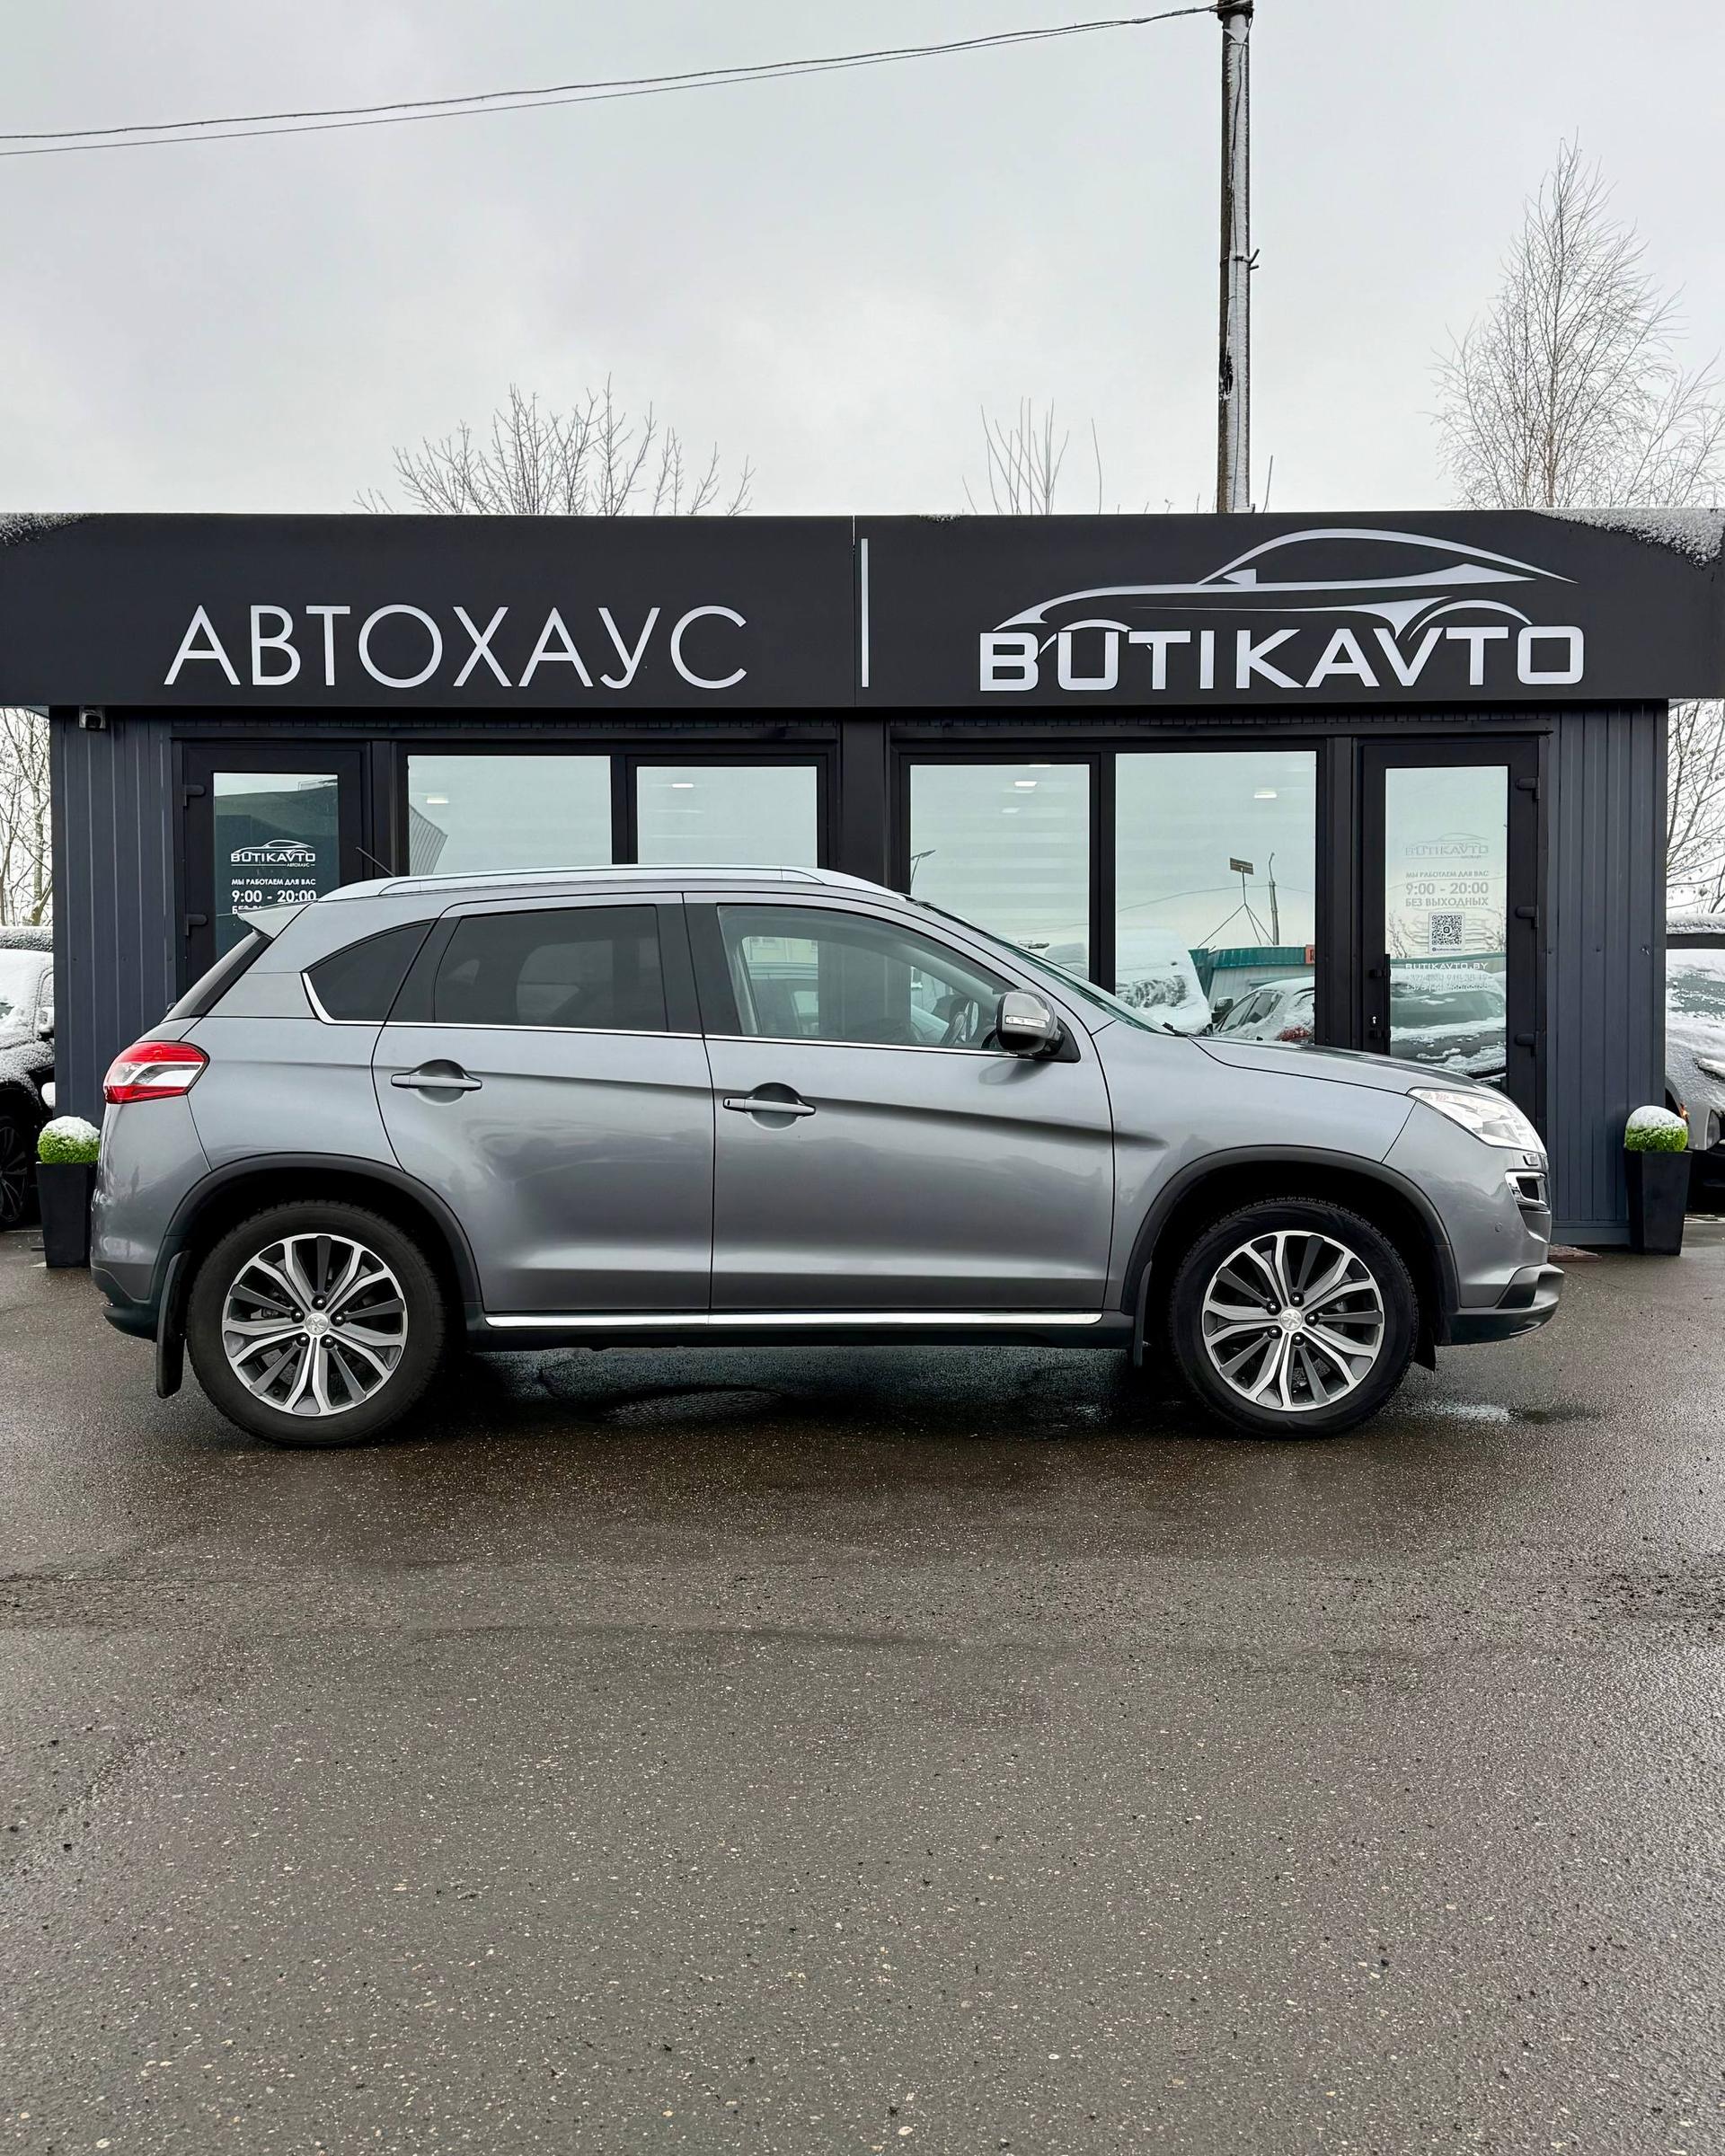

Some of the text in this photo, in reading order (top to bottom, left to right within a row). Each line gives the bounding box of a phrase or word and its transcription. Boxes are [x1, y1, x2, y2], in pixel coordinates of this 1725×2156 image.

[164, 604, 748, 690] АВТОХАУС
[979, 624, 1585, 692] BUTIKAVTO
[230, 853, 316, 862] BUTIKAVTO
[231, 878, 244, 886] МЫ
[1405, 882, 1436, 896] 9:00
[1450, 881, 1490, 895] 20:00
[231, 889, 262, 903] 9:00
[277, 889, 317, 903] 20:00
[1405, 897, 1490, 907] БЕЗ ВЫХОДНЫХ
